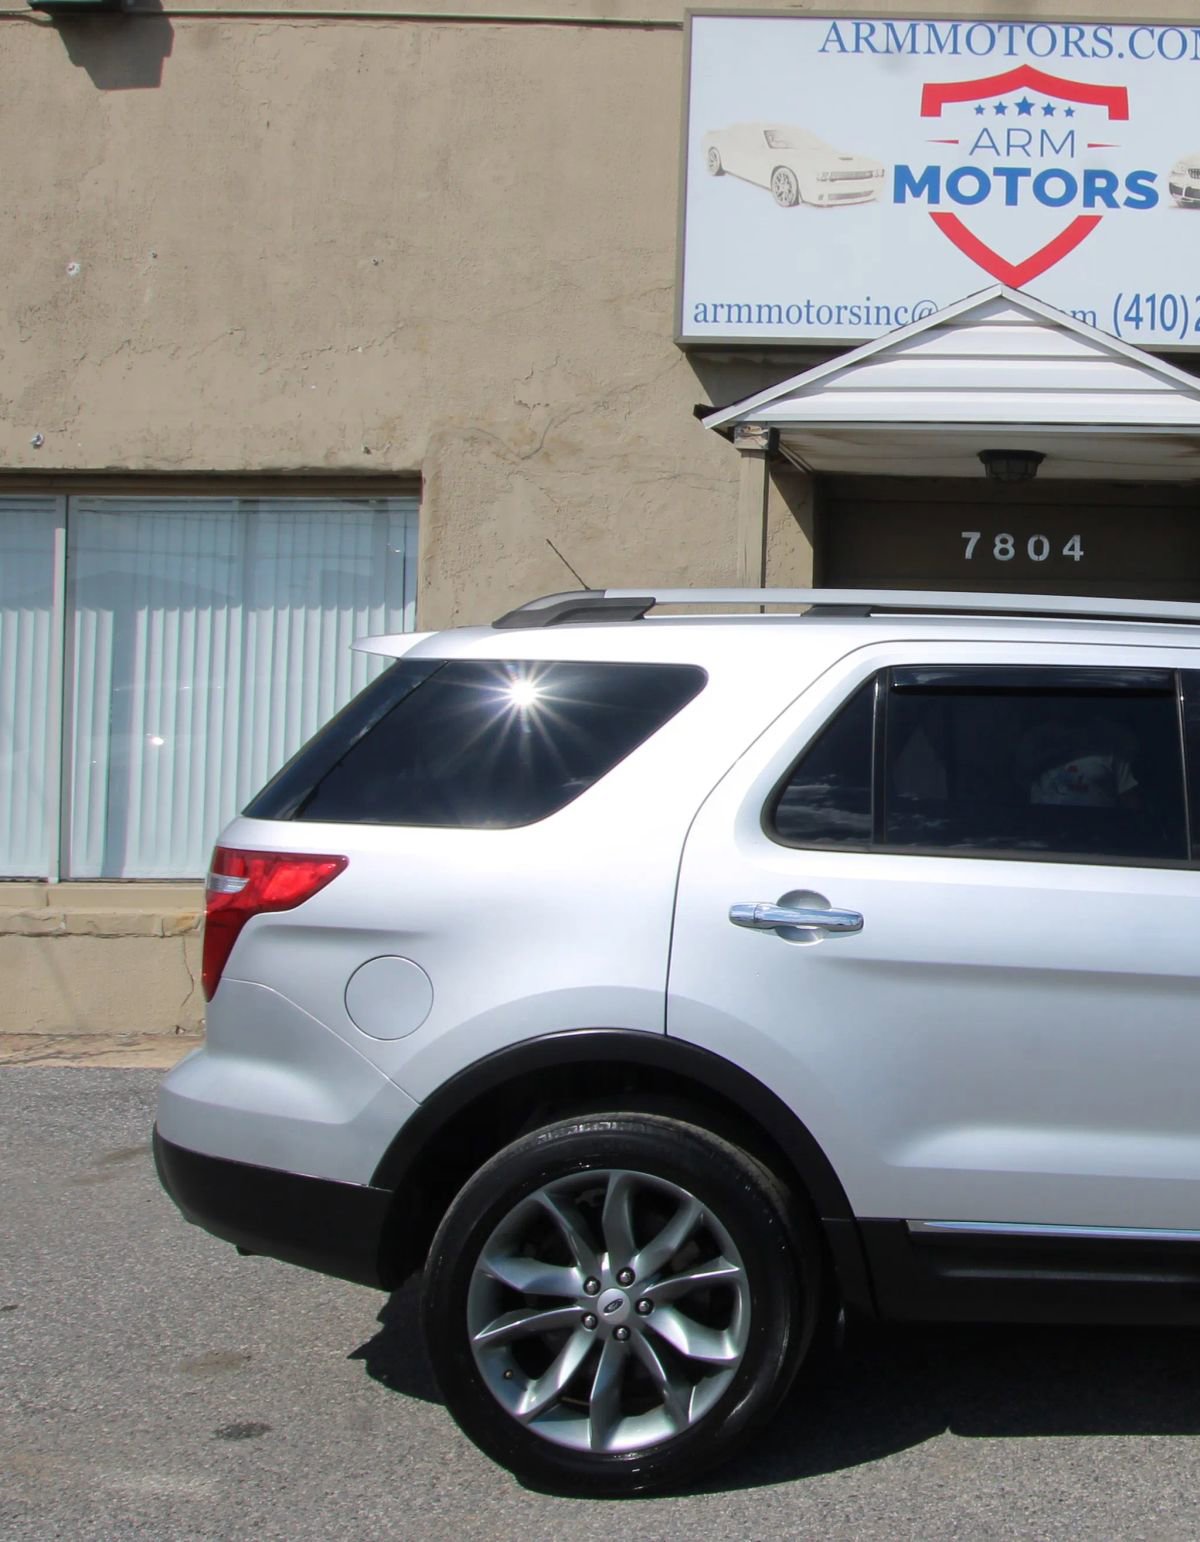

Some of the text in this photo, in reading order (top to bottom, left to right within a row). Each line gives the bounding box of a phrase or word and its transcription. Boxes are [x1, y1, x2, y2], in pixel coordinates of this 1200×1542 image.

[968, 127, 1076, 159] ARM
[893, 164, 1160, 210] MOTORS
[961, 531, 1084, 562] 7804
